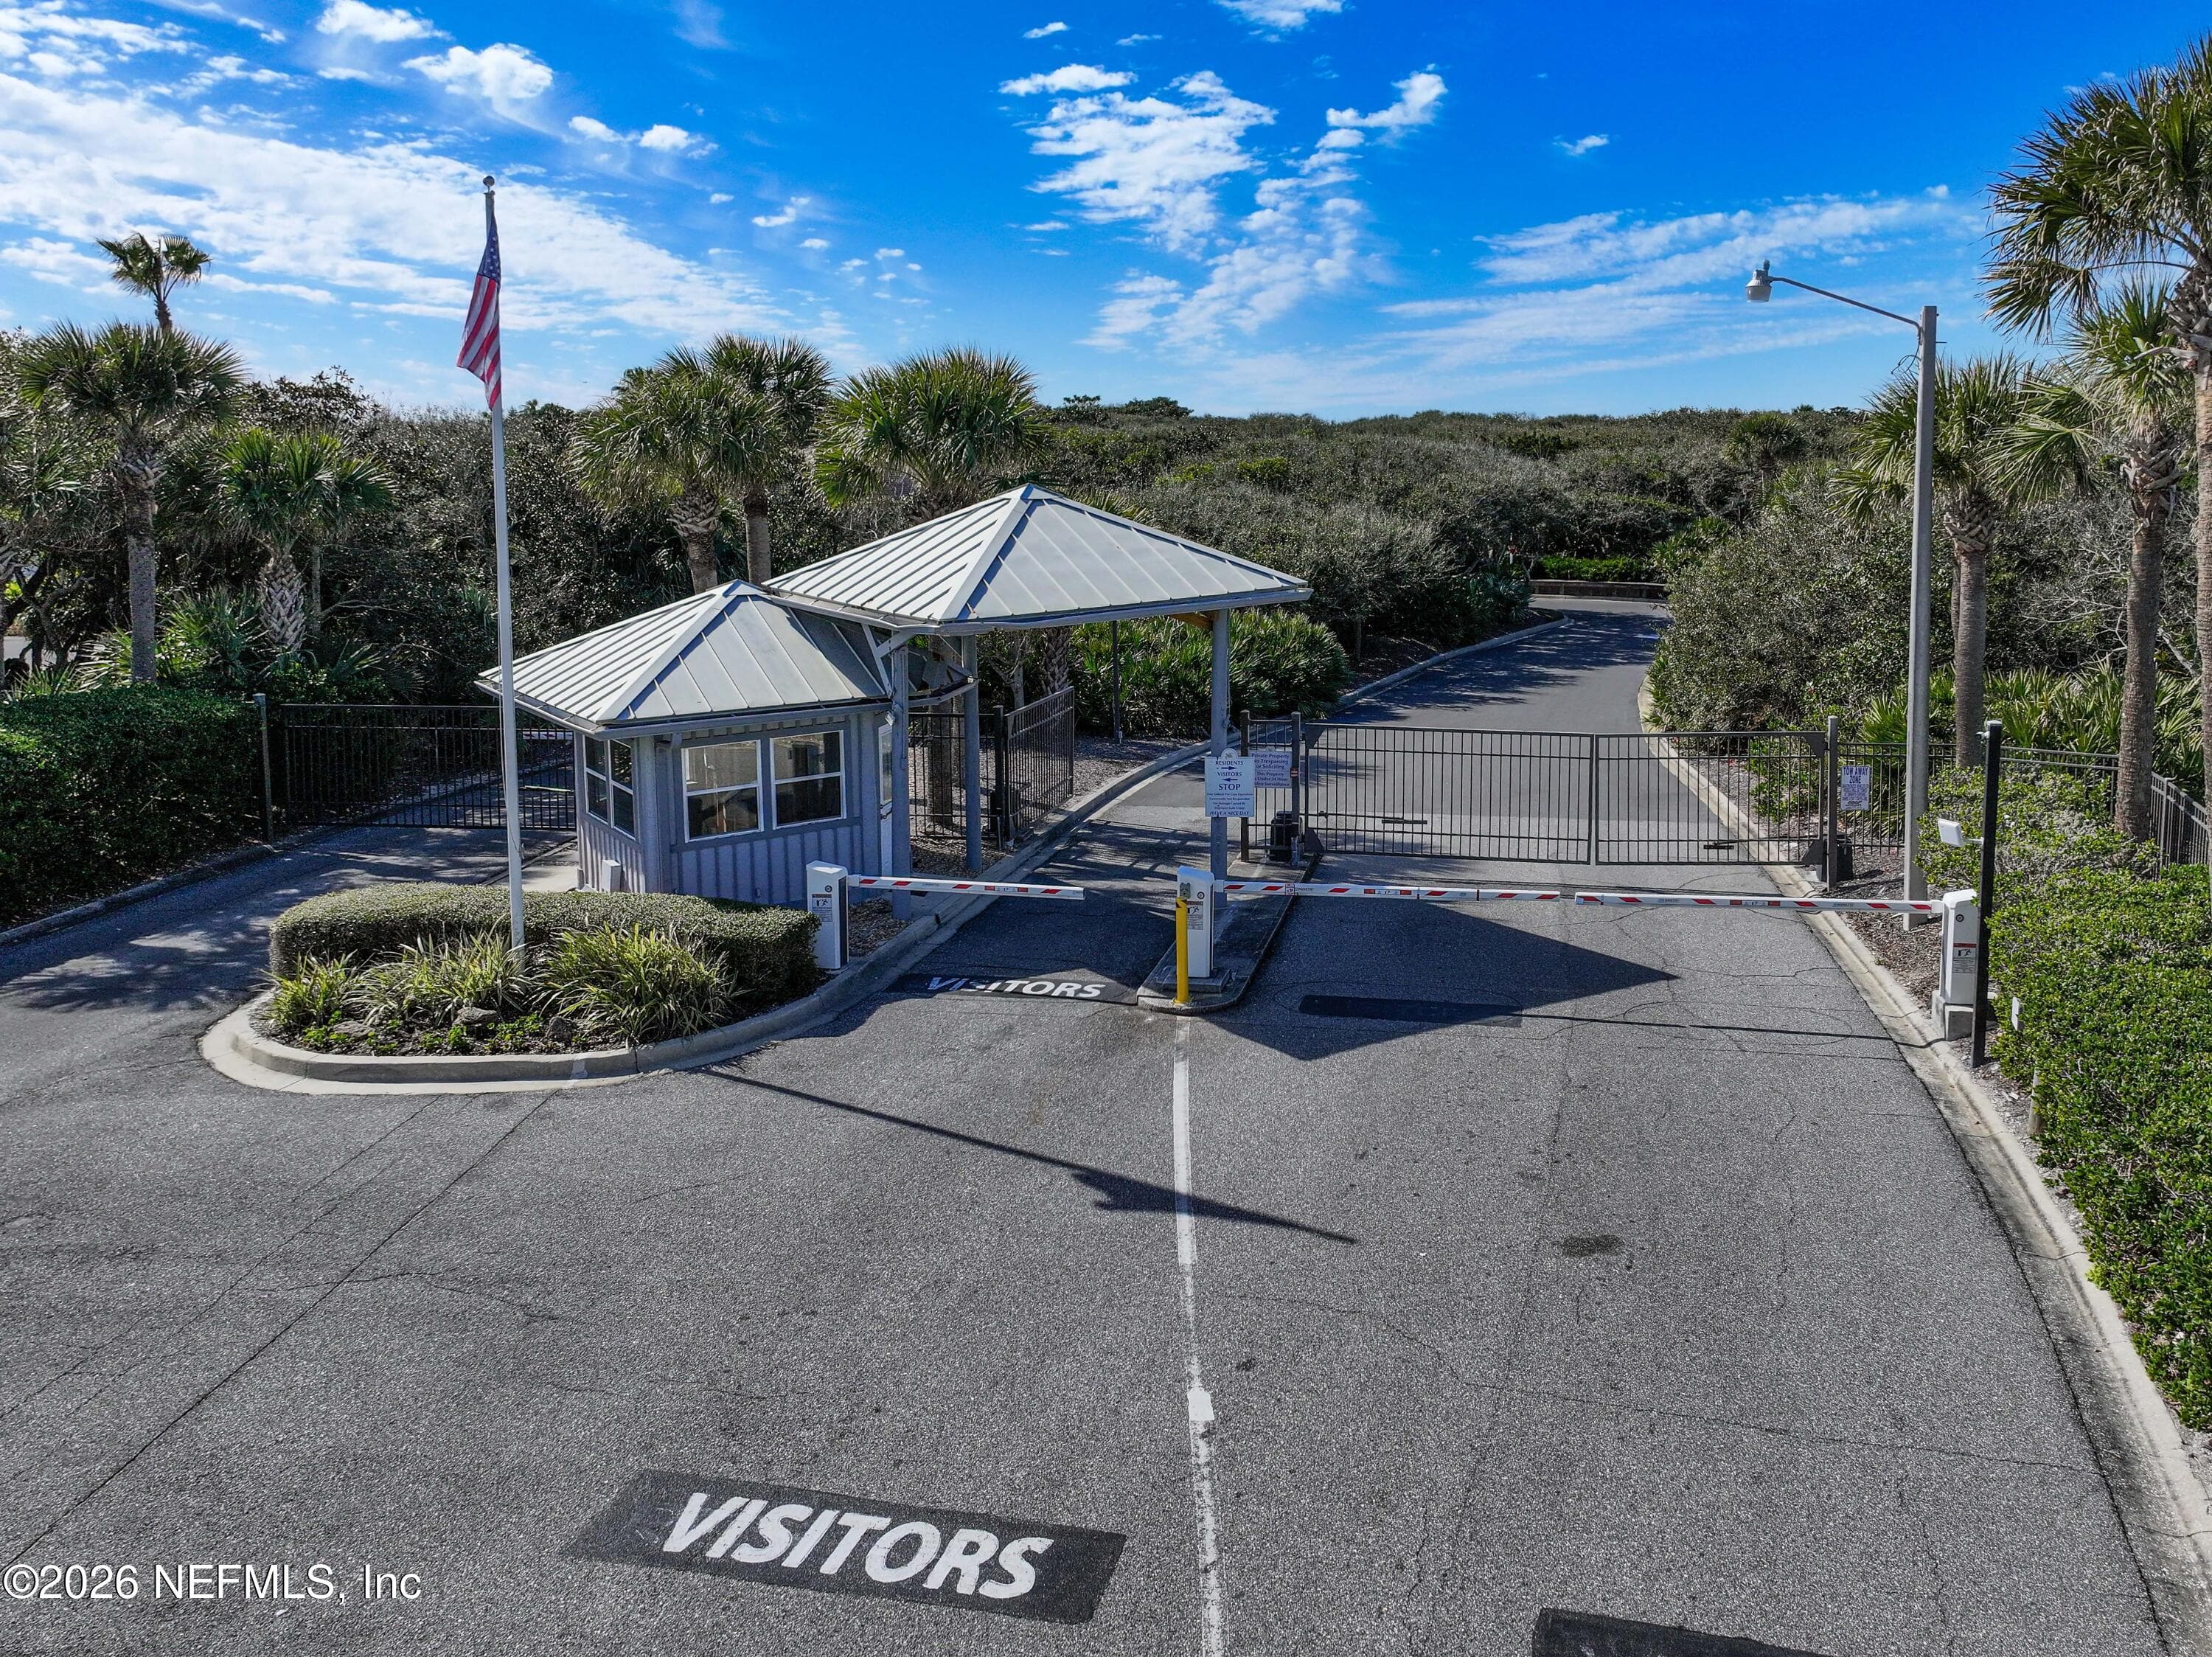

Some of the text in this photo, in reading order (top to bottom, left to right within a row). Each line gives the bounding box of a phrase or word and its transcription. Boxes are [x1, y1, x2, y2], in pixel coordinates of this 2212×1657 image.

[1843, 767, 1868, 776] TOW AWAY
[1849, 776, 1861, 784] ZONE
[928, 976, 1106, 998] VISITORS
[663, 1493, 1054, 1599] VISITORS
